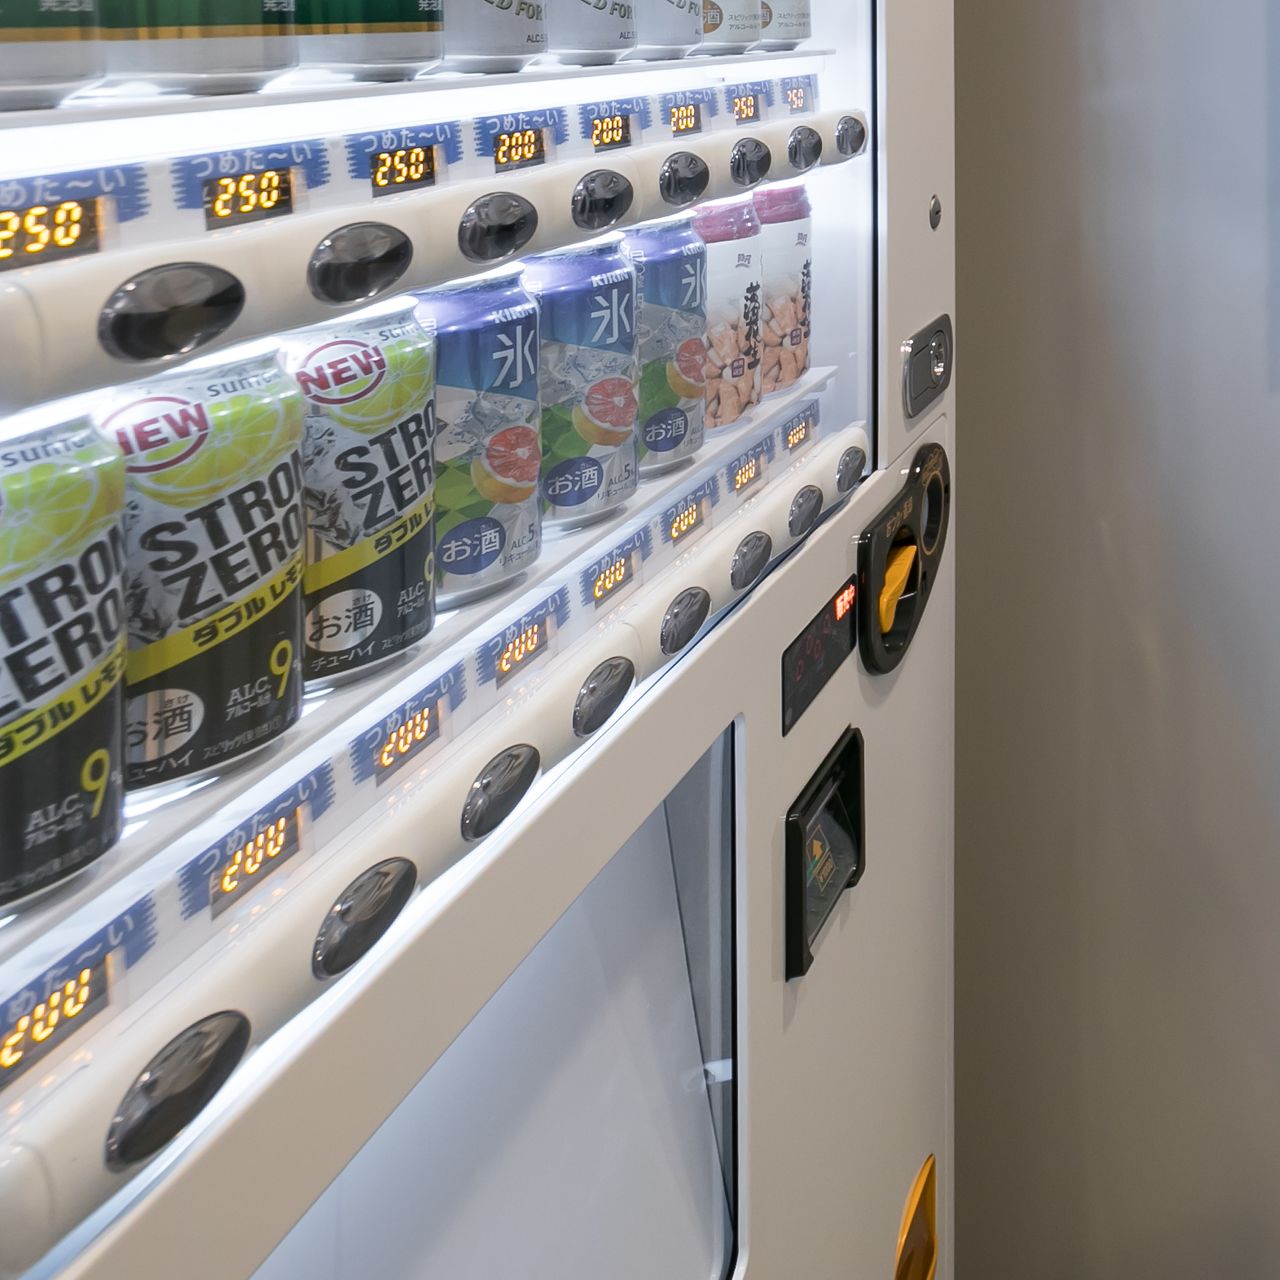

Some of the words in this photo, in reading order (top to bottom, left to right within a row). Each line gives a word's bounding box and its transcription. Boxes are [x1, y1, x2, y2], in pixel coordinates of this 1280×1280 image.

[671, 104, 696, 133] 200
[733, 95, 755, 121] 250
[497, 129, 536, 165] 200
[592, 115, 624, 147] 200
[375, 147, 425, 188] 250
[214, 169, 281, 218] 250
[590, 269, 631, 289] KIRIN
[590, 287, 632, 345] 氷
[296, 343, 387, 396] NEW
[492, 324, 537, 390] 氷
[645, 417, 687, 447] お酒
[546, 465, 600, 496] お酒
[161, 502, 302, 621] ZERO
[441, 524, 502, 564] お酒
[308, 604, 376, 644] お酒
[311, 639, 378, 673] チューハイ
